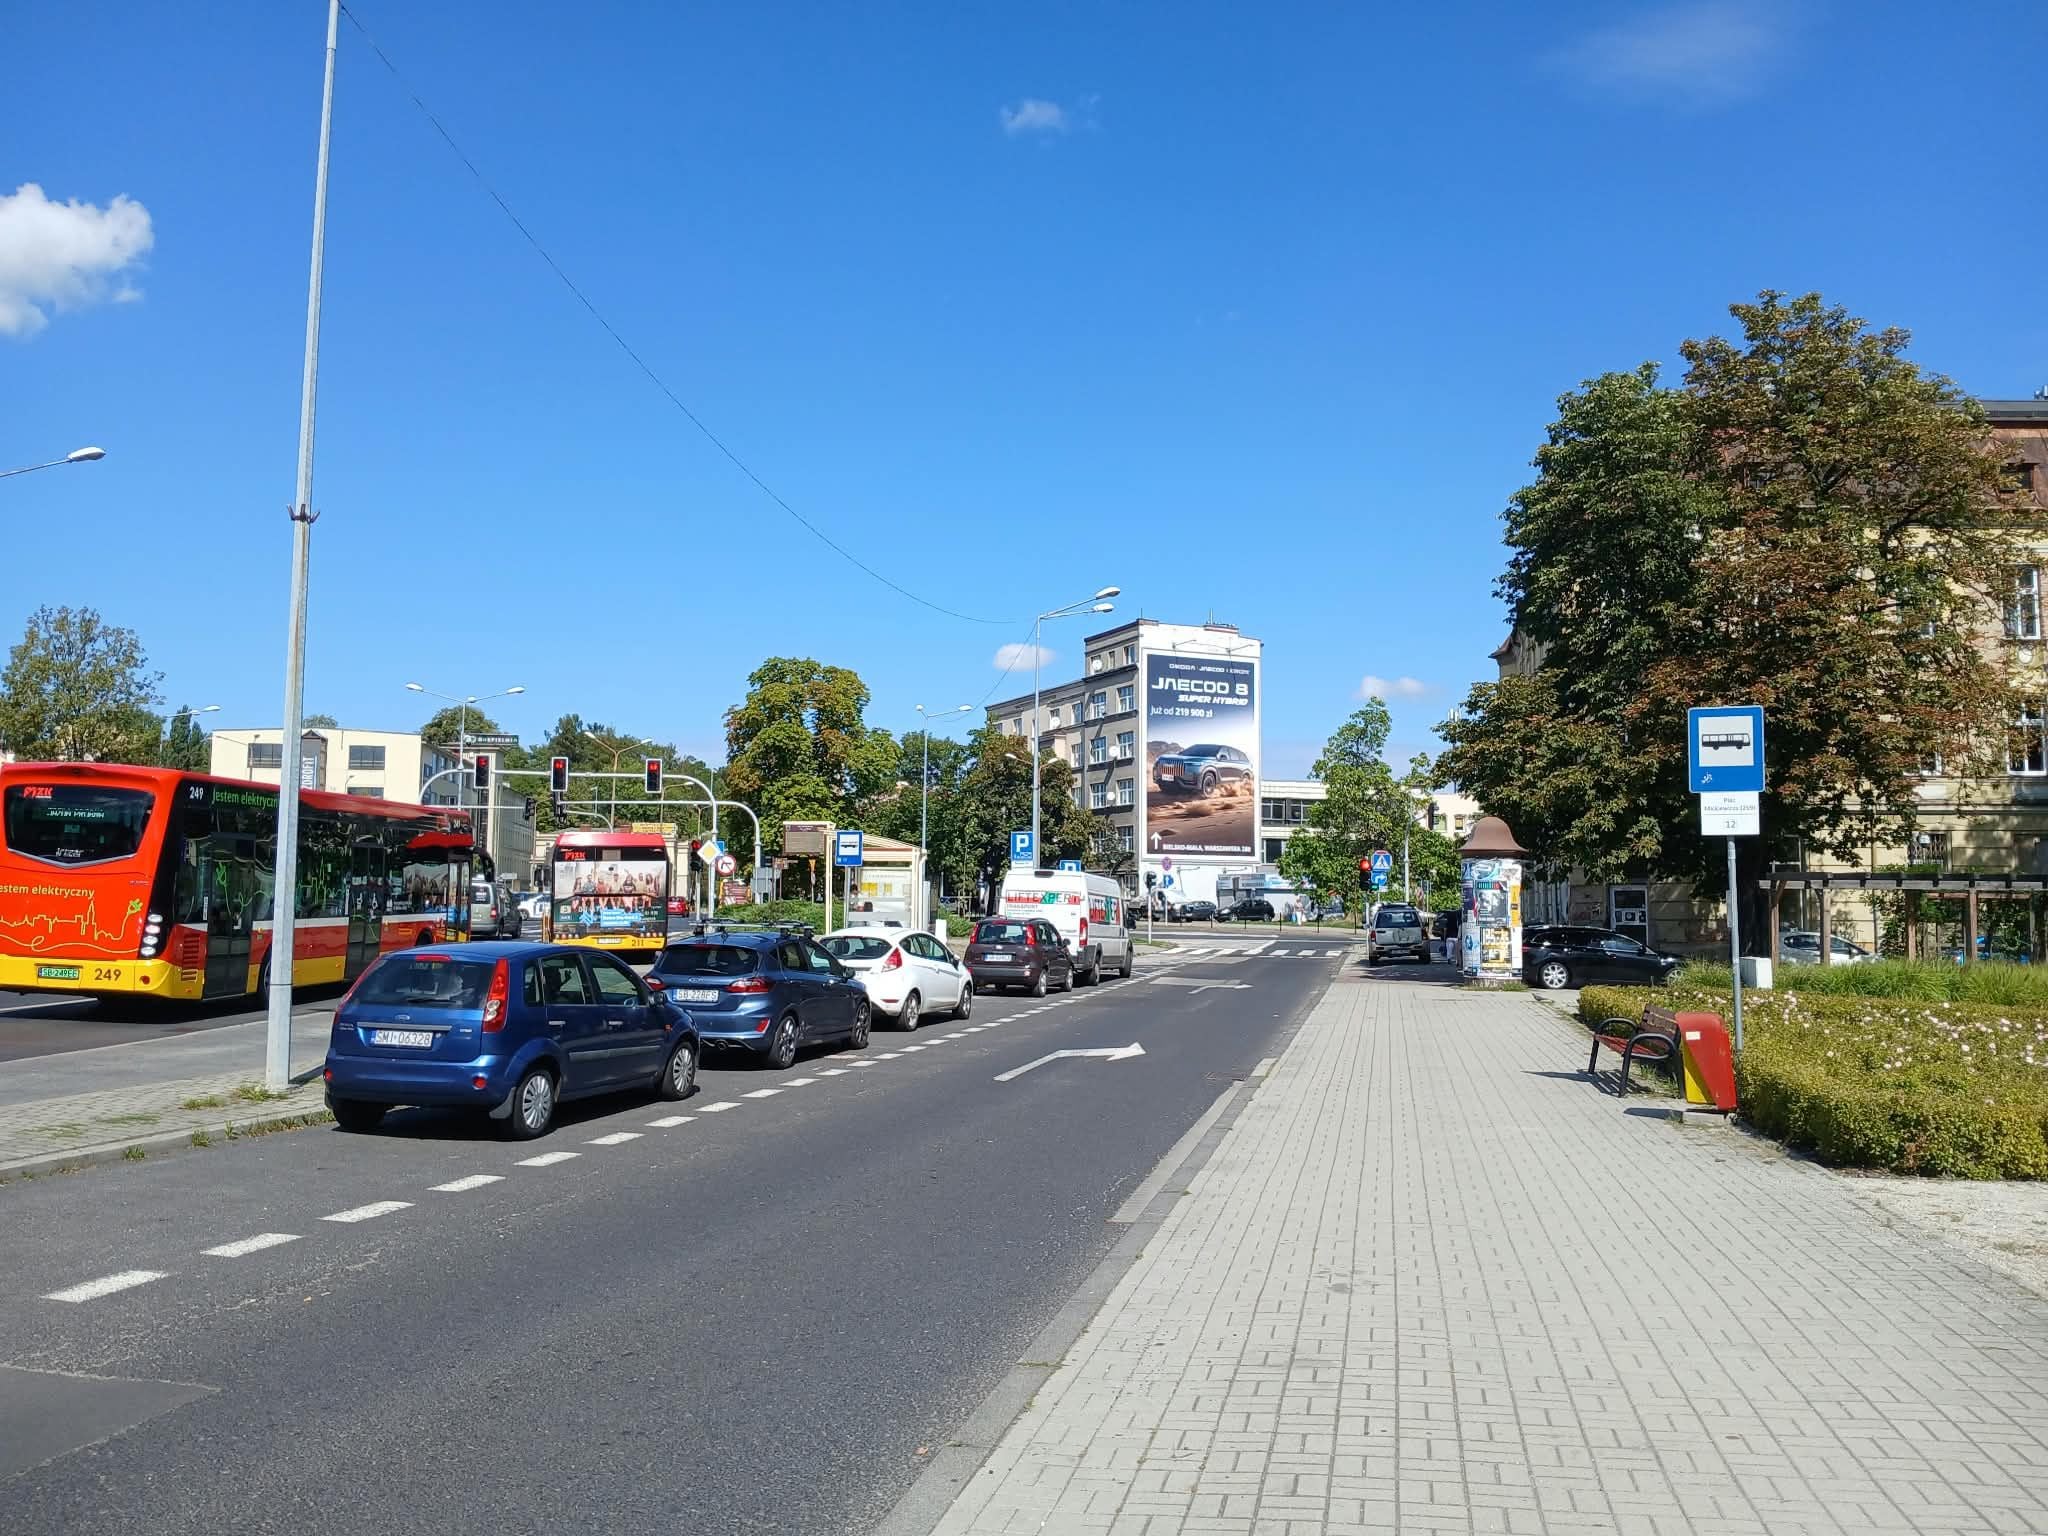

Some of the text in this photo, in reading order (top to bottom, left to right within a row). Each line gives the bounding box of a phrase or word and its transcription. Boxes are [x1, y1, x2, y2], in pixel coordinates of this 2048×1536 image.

[1152, 677, 1249, 696] JAECOO 8
[1178, 694, 1249, 706] SUPER HYBRID
[1163, 706, 1174, 715] od
[189, 786, 204, 800] 249
[211, 787, 240, 805] Jestem
[1725, 820, 1736, 829] 12
[1016, 834, 1029, 852] P
[32, 885, 95, 899] elektryczny
[94, 968, 122, 982] 249
